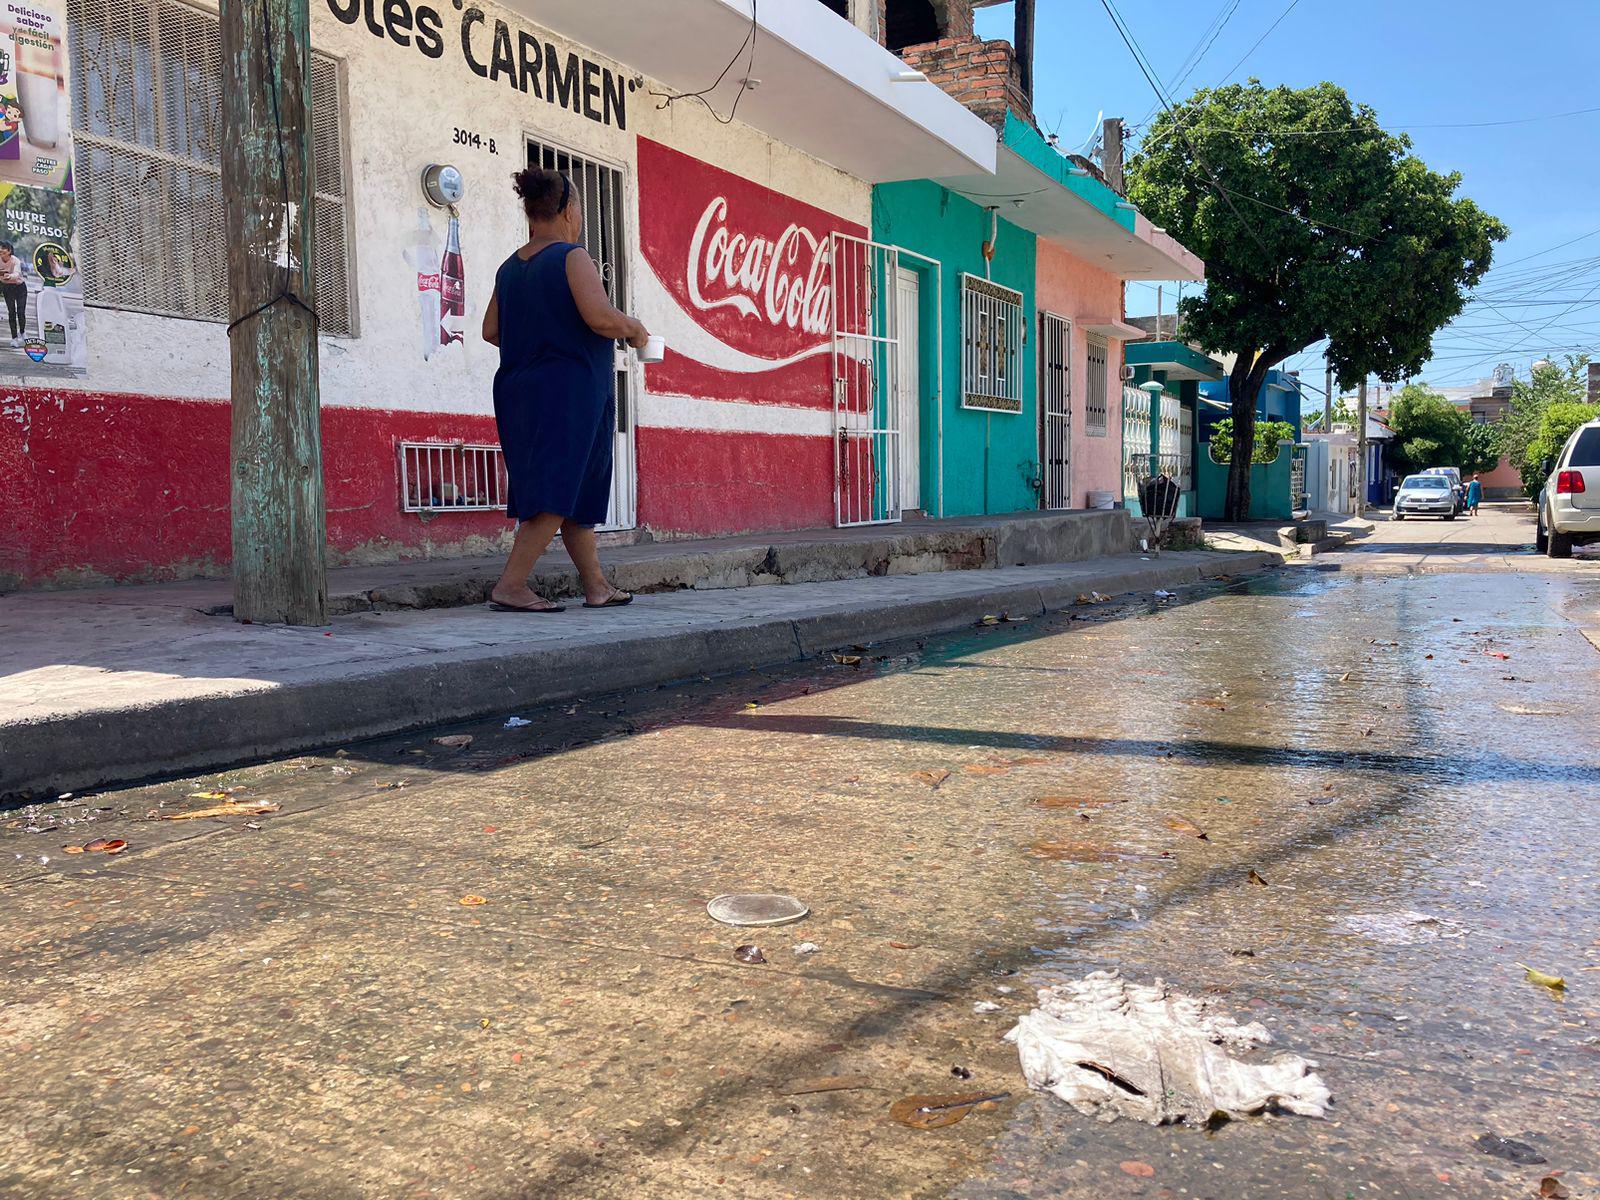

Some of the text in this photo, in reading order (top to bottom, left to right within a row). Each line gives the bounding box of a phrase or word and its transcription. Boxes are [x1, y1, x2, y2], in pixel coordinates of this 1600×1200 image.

[8, 4, 52, 22] Delicioso
[16, 17, 45, 29] sabor
[9, 33, 54, 51] digestión
[28, 27, 50, 40] fácil
[6, 209, 46, 224] NUTRE
[7, 221, 69, 239] SUS PASOS
[687, 196, 832, 336] Coca-Cola
